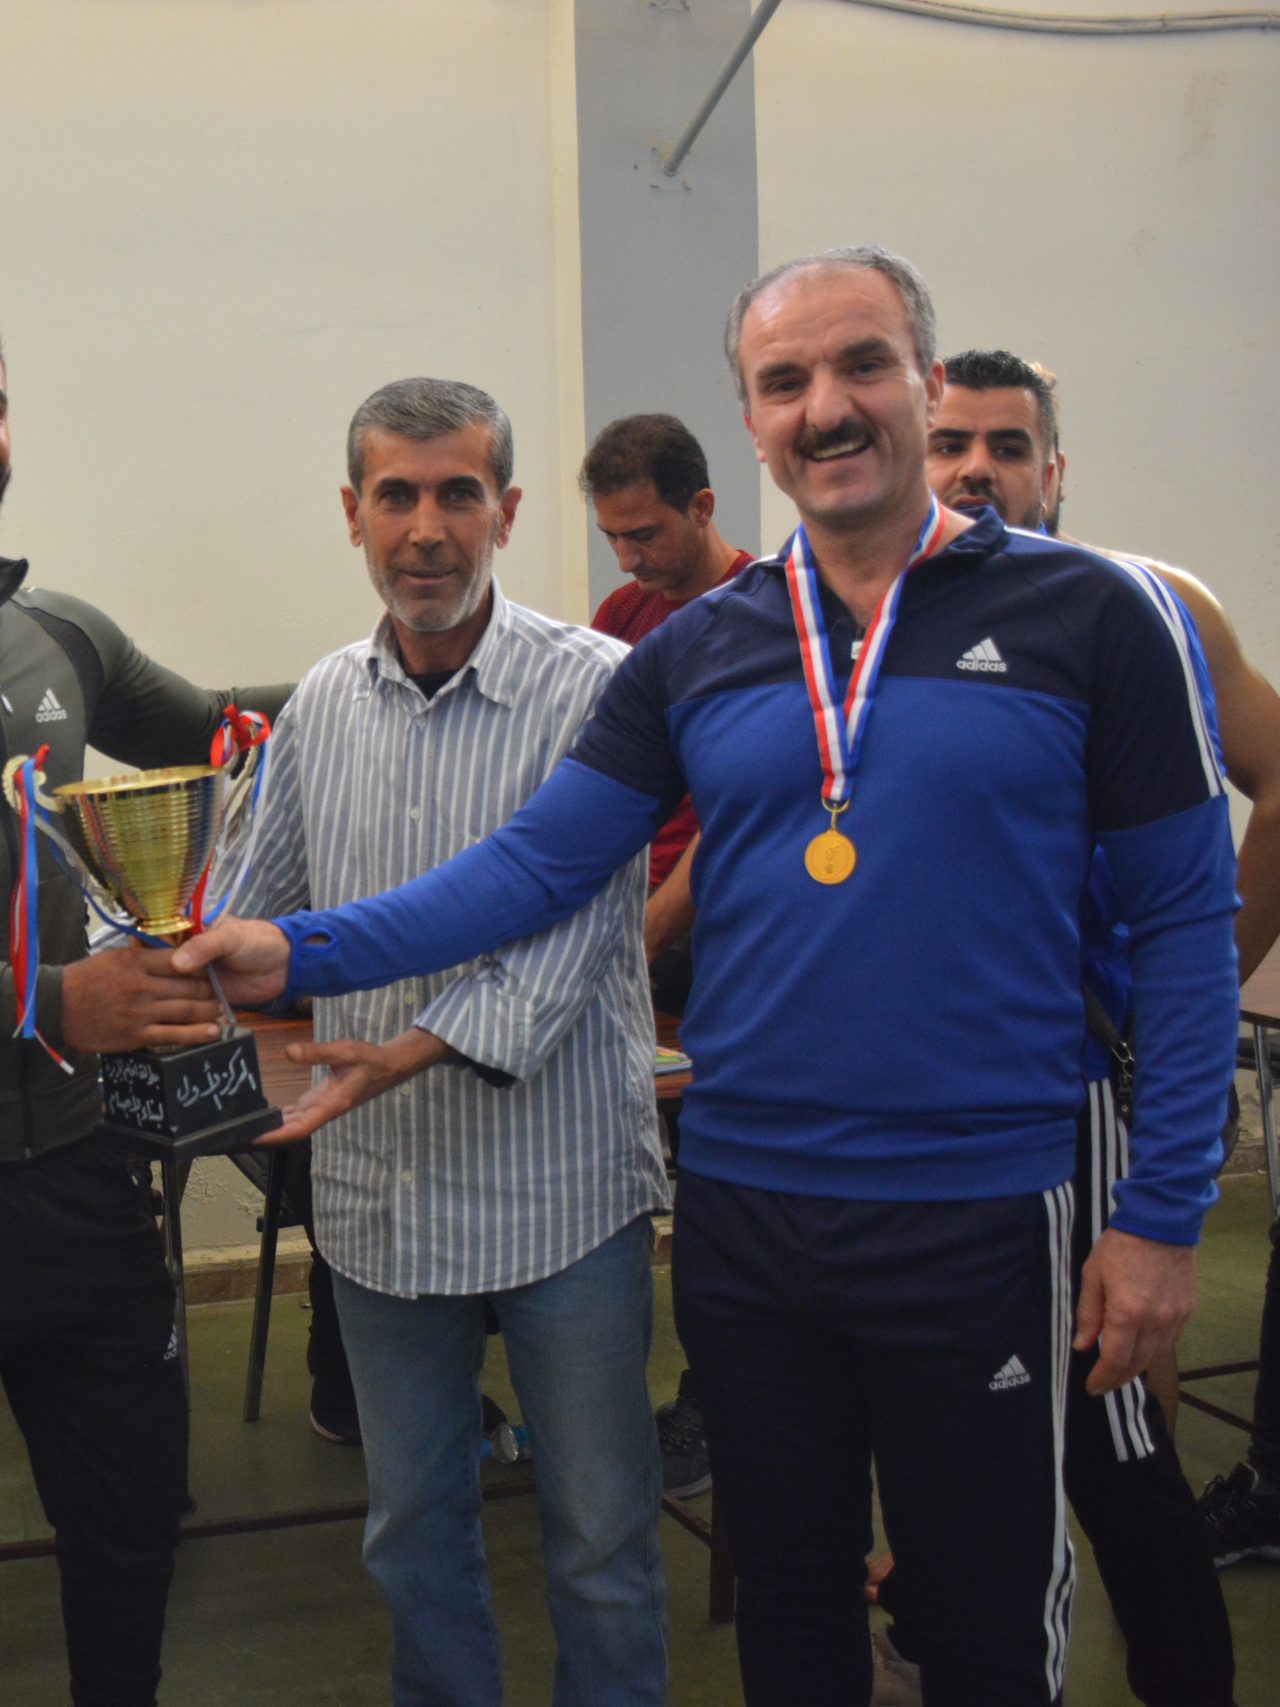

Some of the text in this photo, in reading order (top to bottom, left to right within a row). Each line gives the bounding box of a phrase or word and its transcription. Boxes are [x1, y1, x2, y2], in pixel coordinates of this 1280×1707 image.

[956, 659, 1007, 672] adidas
[35, 709, 67, 723] adidas
[220, 1046, 257, 1095] المركز
[988, 1373, 1031, 1391] adidas
